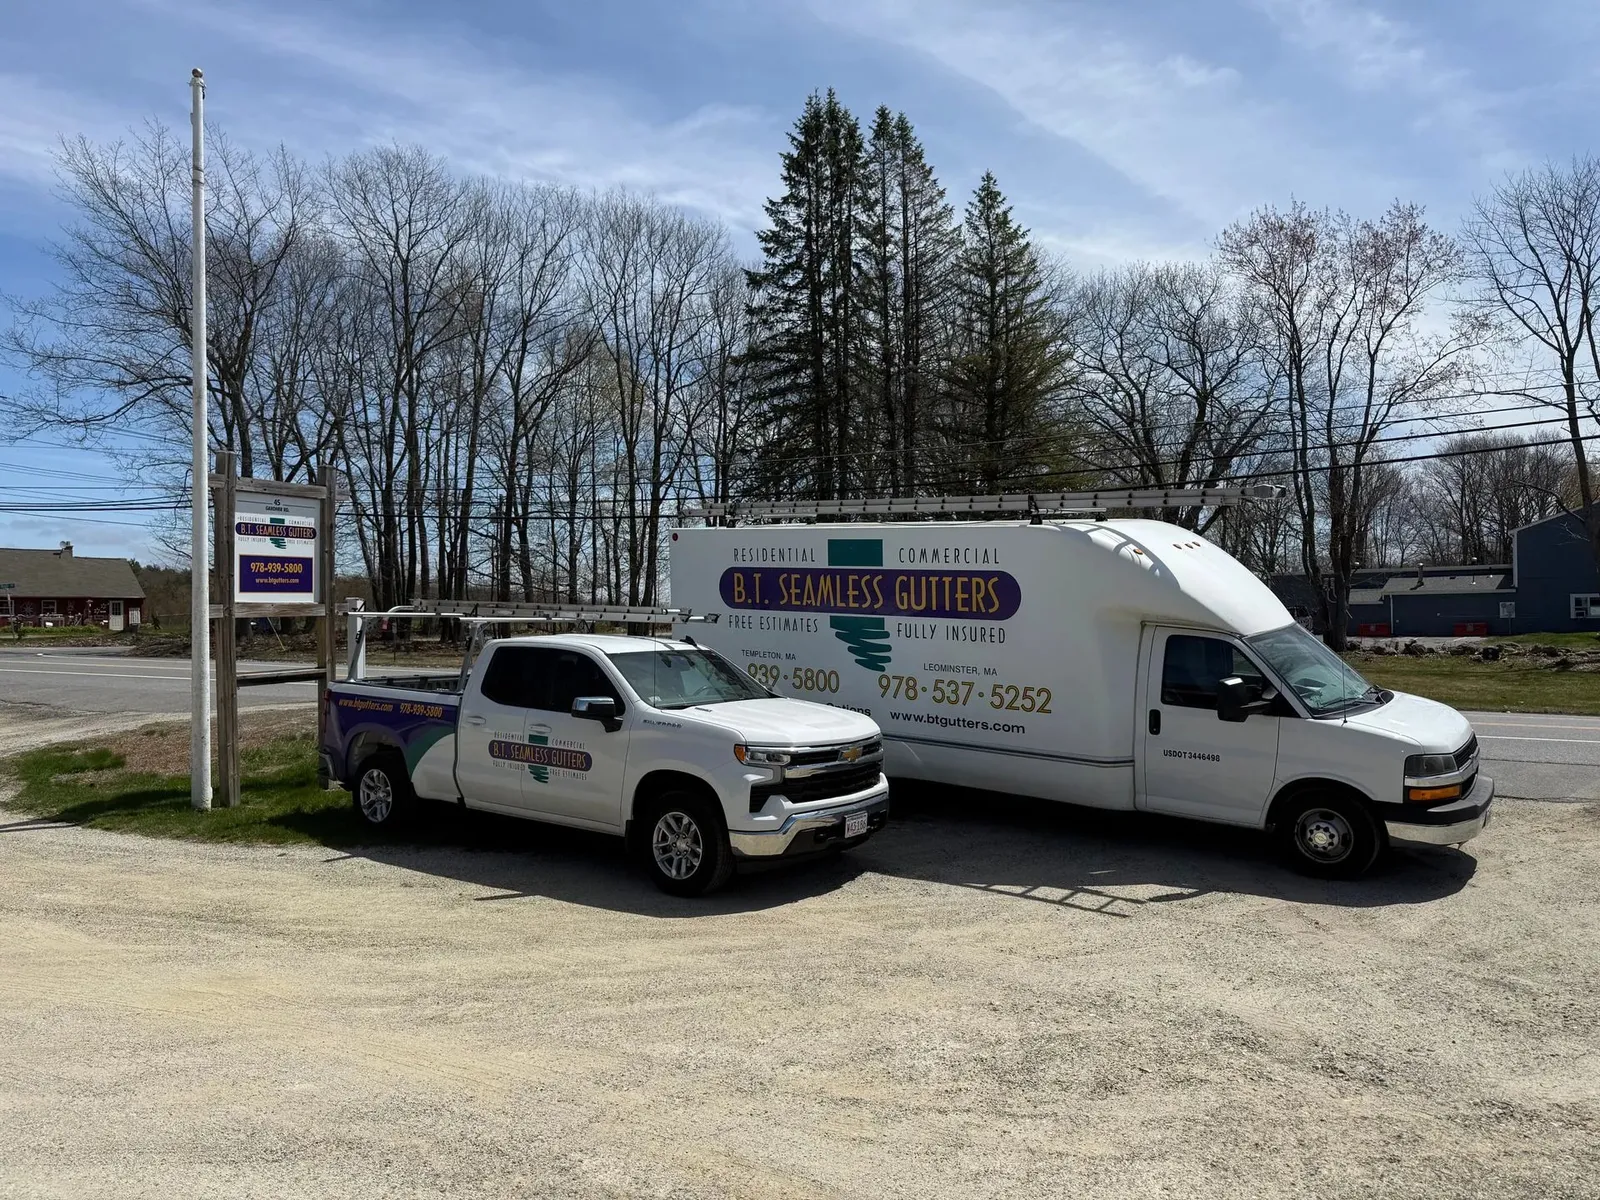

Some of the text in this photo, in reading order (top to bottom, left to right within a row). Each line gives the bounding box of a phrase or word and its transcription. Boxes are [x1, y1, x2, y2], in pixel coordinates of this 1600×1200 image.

[240, 524, 314, 538] B.T. SEAMLESS GUTTERS
[733, 547, 816, 562] RESIDENTIAL
[898, 547, 1000, 564] COMMERCIAL
[250, 562, 303, 573] 978-939-5800
[255, 576, 300, 585] www.btgutters.com
[733, 572, 1000, 614] B.T. SEAMLESS GUTTERS
[728, 614, 818, 633] FREE ESTIMATES
[896, 622, 1006, 644] FULLY INSURED
[741, 649, 784, 660] TEMPLETON,
[923, 662, 998, 676] LEOMINSTER, MA
[338, 698, 443, 718] www.btgutters.com 978-939-5800
[890, 710, 1026, 734] www.btgutters.com
[552, 738, 586, 750] COMMERCIAL
[493, 742, 586, 769] B.T. SEAMLESS GUTTERS
[550, 768, 588, 781] FREE ESTIMATES
